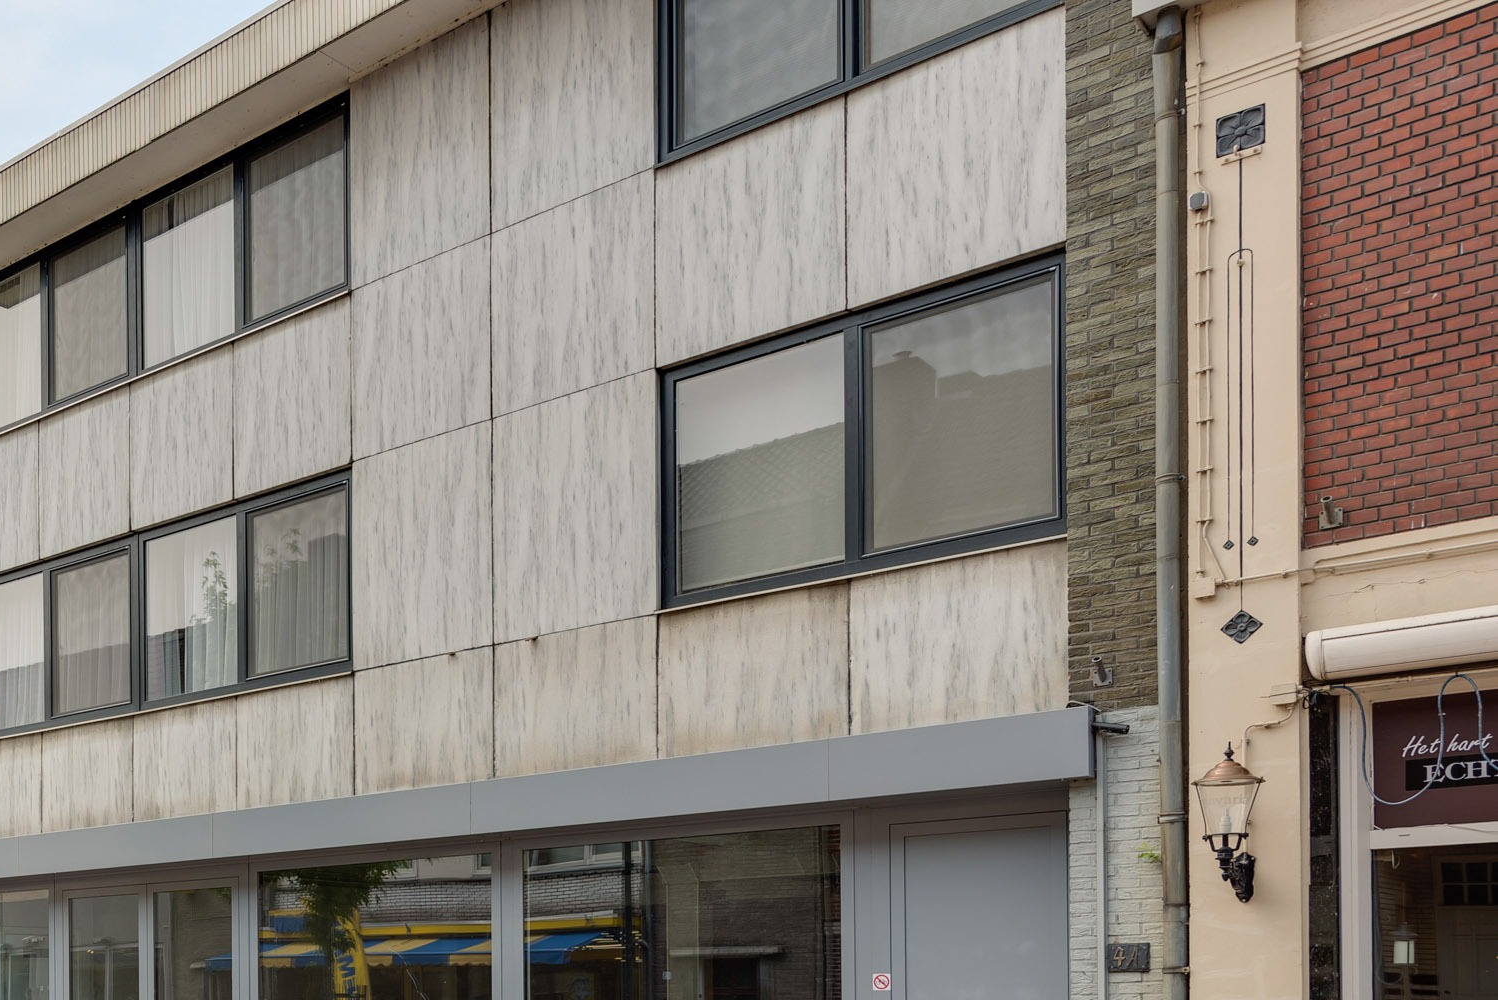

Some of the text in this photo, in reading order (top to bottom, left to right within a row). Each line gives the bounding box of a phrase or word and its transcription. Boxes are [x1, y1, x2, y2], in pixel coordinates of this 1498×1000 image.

[1402, 733, 1493, 758] Het hart
[1113, 946, 1139, 967] 4A
